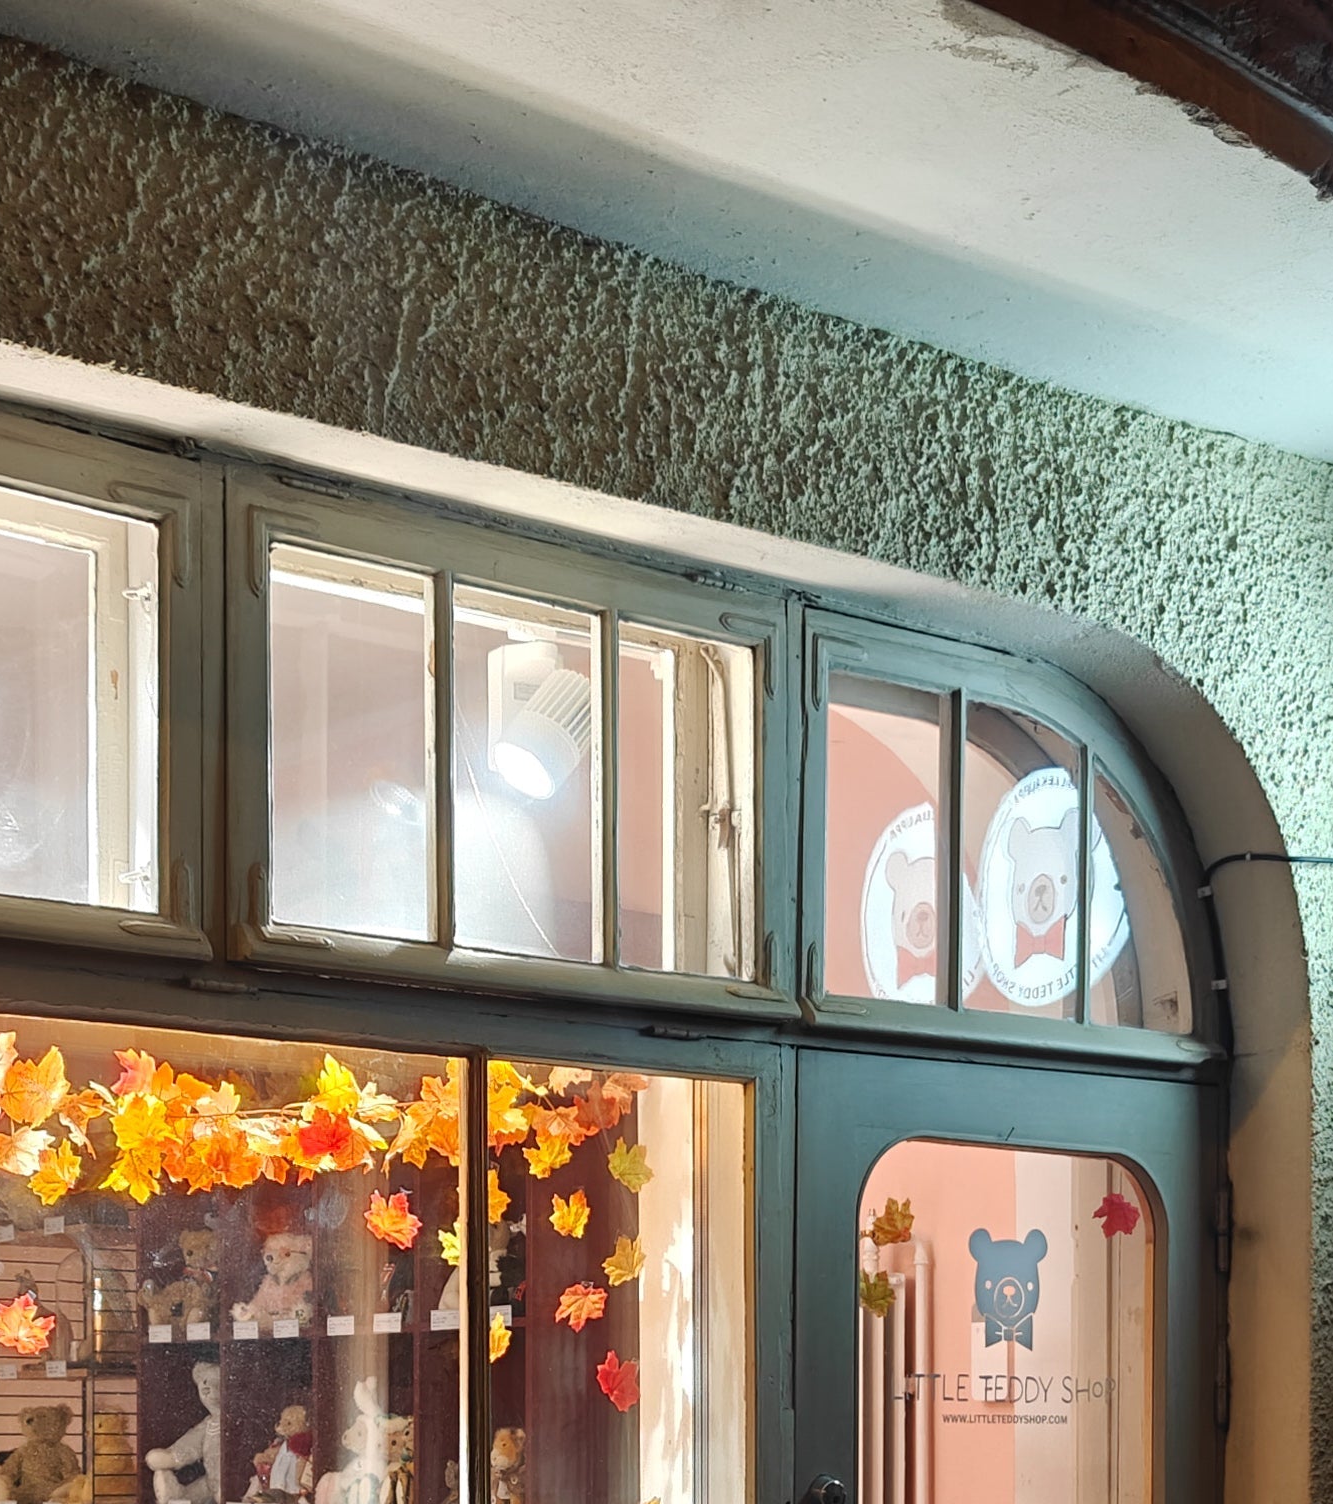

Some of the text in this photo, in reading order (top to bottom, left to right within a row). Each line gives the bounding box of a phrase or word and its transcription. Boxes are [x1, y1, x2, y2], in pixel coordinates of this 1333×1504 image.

[979, 1375, 1054, 1403] TEDDY
[1061, 1375, 1116, 1404] SHOP
[942, 1414, 1068, 1424] WWW.LITTLETEDDYSHOP.COM
